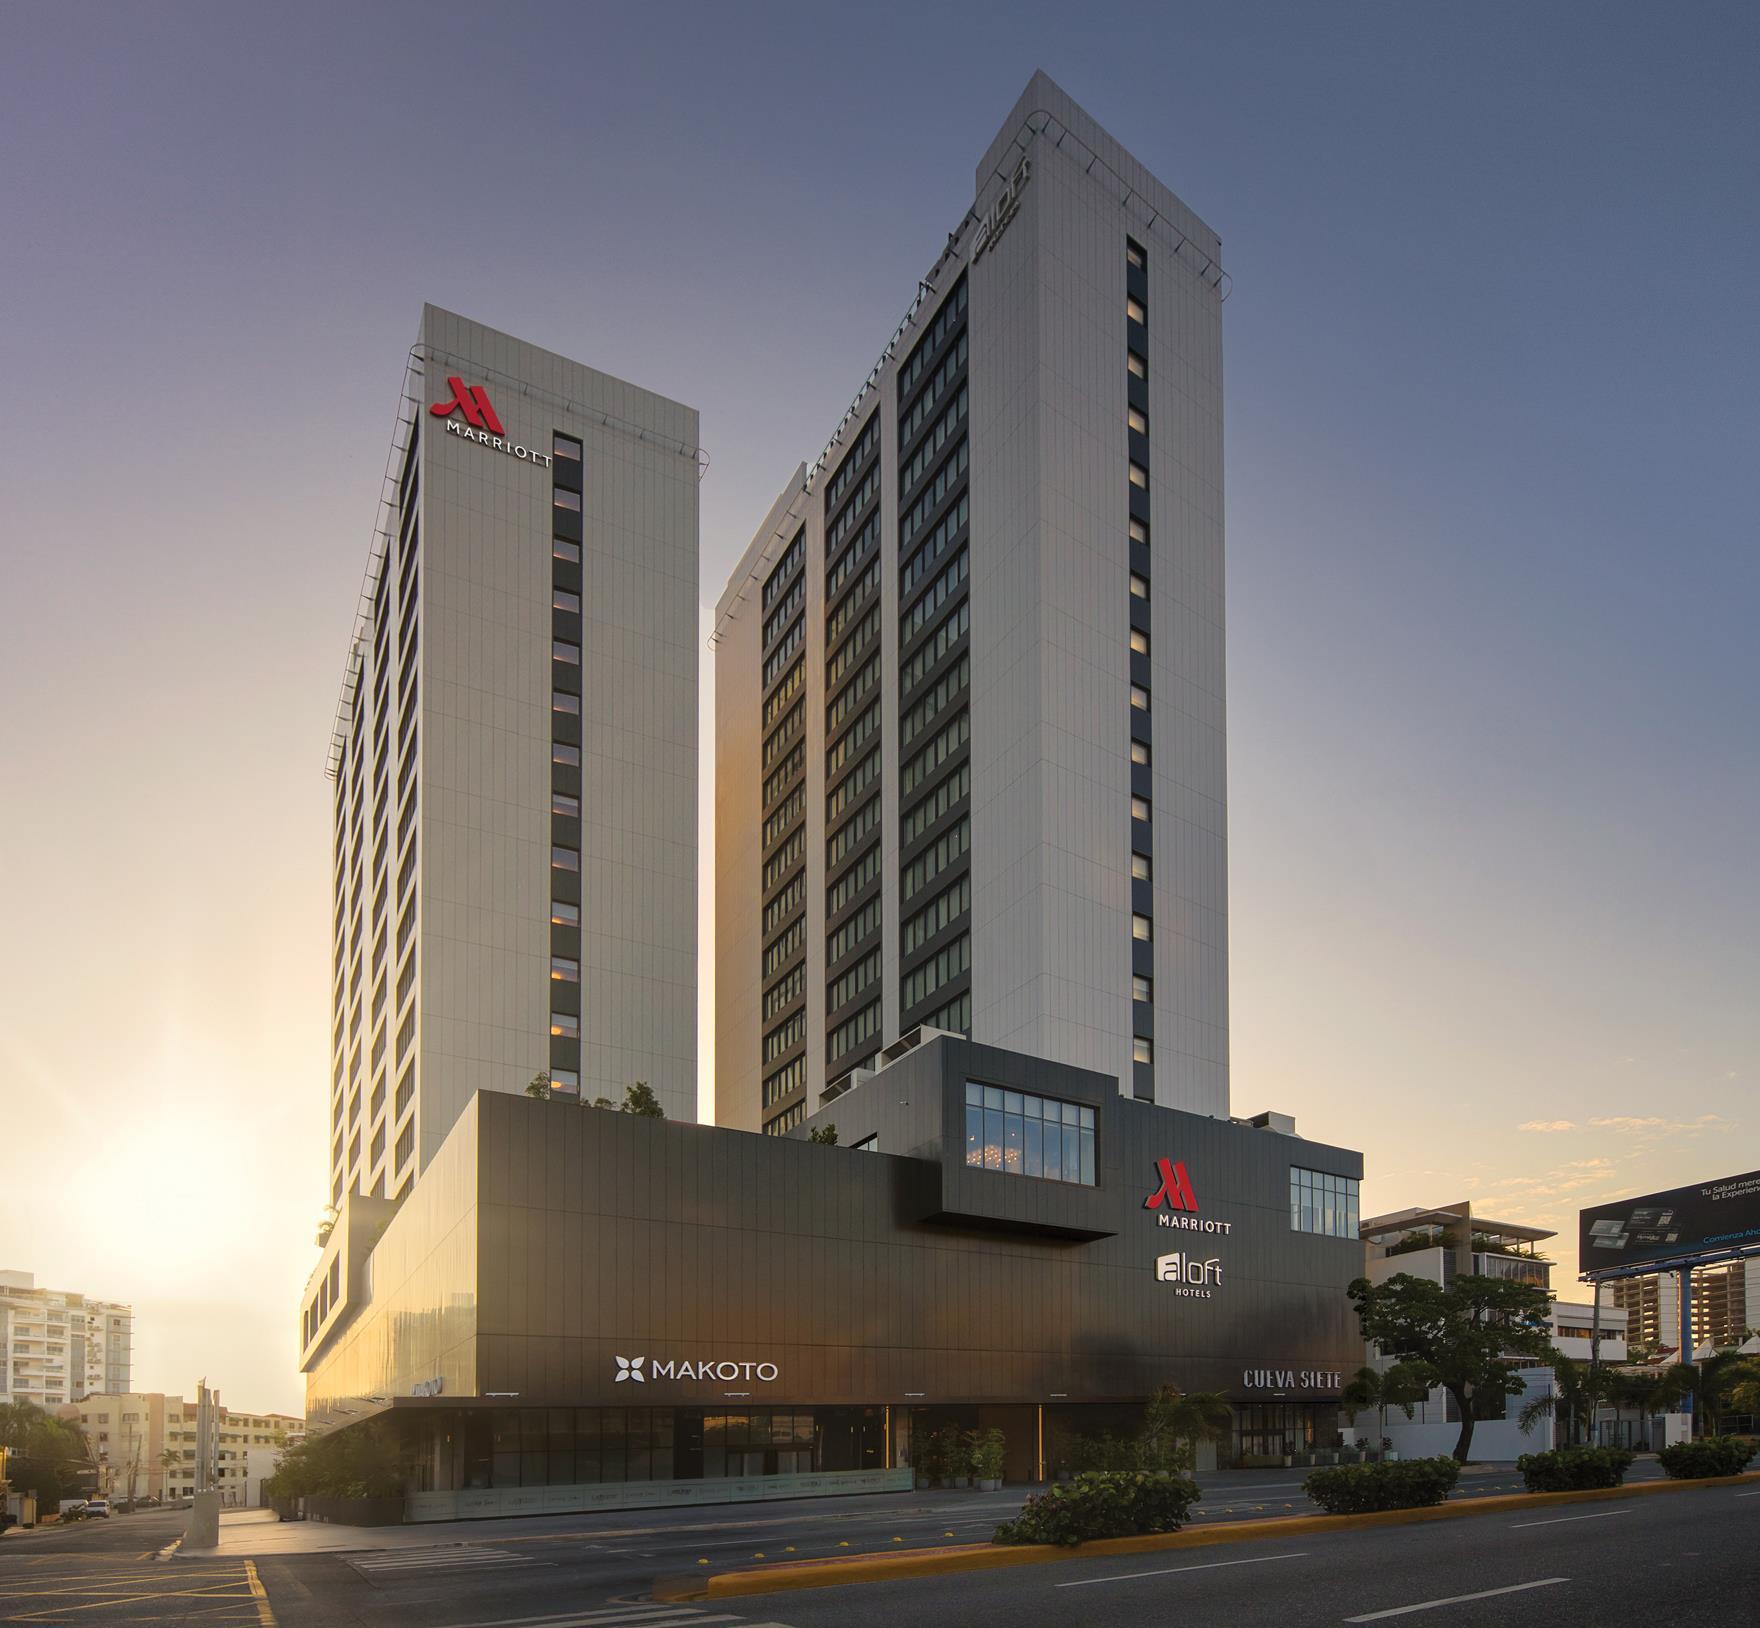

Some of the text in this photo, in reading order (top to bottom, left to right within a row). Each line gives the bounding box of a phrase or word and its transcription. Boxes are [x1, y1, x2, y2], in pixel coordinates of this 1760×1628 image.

[446, 419, 553, 468] MARRIOTT
[1701, 1188, 1711, 1196] Tu
[1712, 1182, 1737, 1194] Salud
[1158, 1213, 1232, 1236] MARRIOTT
[1156, 1251, 1223, 1286] aloft
[1175, 1287, 1212, 1299] HOTELS
[652, 1359, 779, 1382] MAKOTO
[1243, 1369, 1342, 1389] CUEVA SIETE
